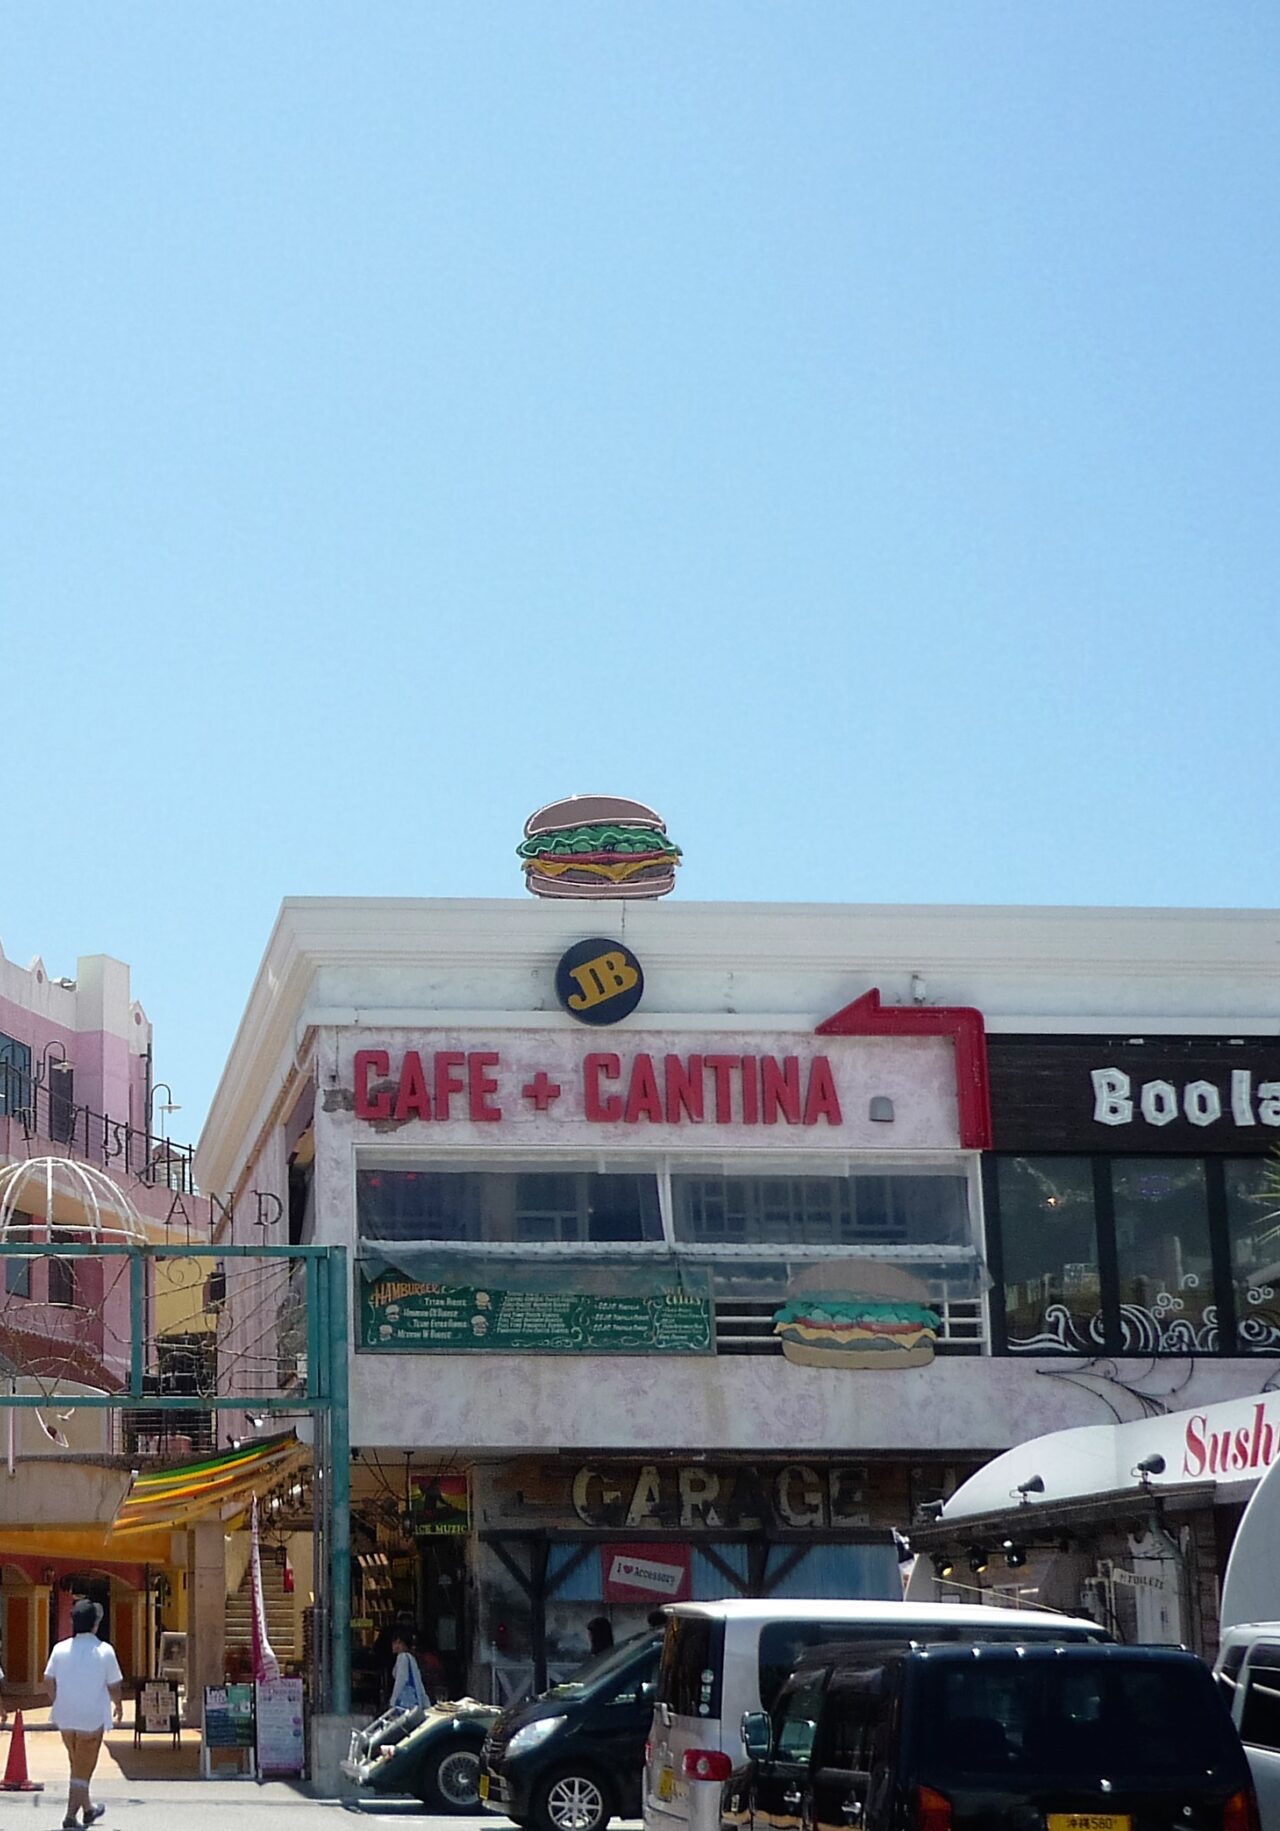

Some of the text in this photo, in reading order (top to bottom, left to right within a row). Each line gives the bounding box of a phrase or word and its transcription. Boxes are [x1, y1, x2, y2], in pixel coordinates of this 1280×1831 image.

[567, 950, 638, 1011] JB
[353, 1049, 501, 1122] CAFE
[583, 1052, 843, 1125] CANTINA
[572, 1464, 870, 1529] GARAGE
[634, 1566, 675, 1586] Accessory
